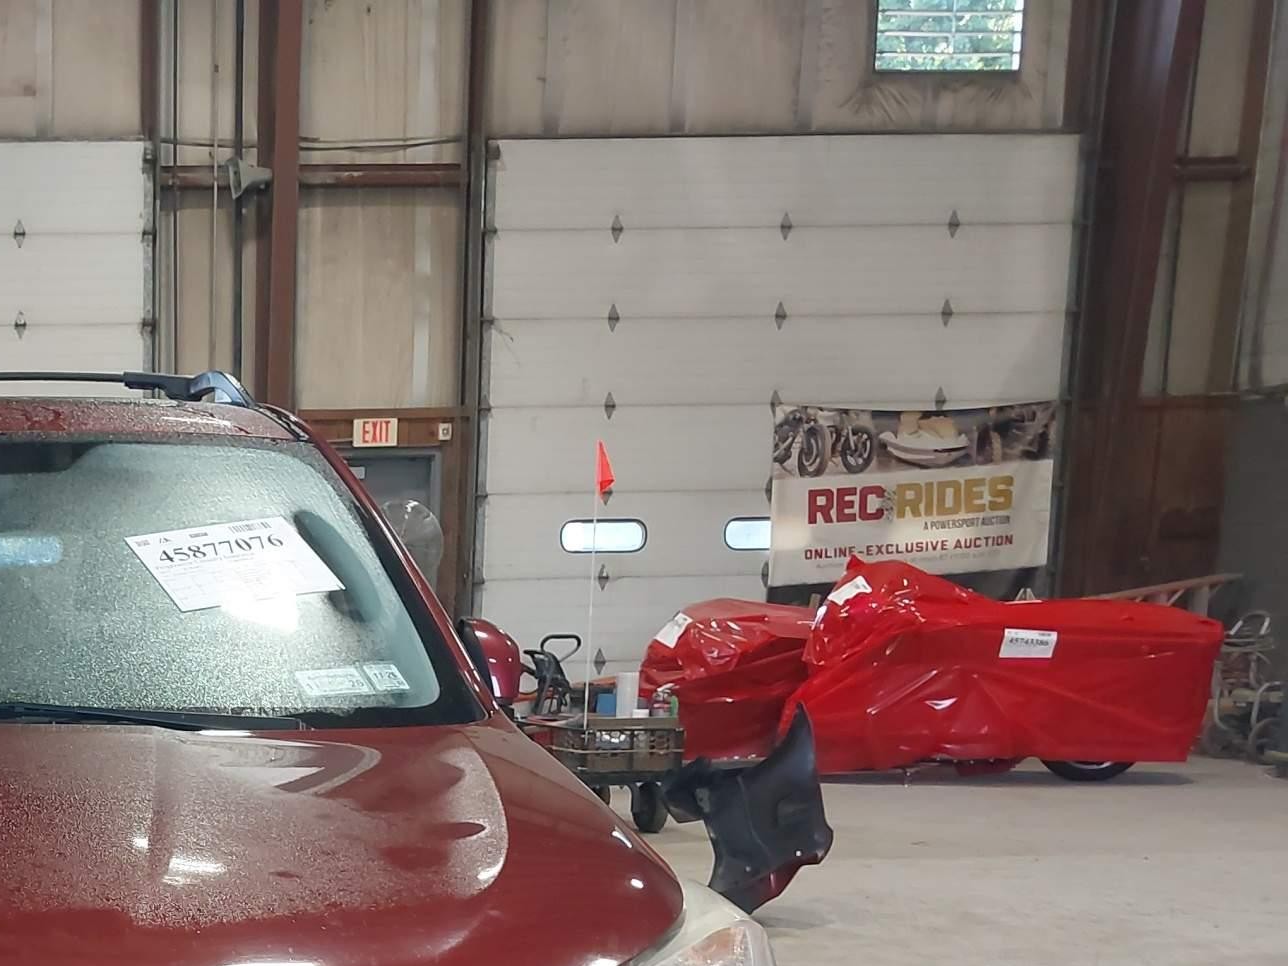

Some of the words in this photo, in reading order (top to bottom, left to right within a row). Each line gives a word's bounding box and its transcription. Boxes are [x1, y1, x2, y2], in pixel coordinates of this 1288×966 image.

[362, 420, 391, 443] EXIT
[808, 485, 885, 524] REC
[895, 475, 1014, 519] RIDES
[981, 515, 1011, 526] AUCTION
[159, 533, 284, 563] 45877076
[804, 539, 948, 560] ONLINE-EXCLUSIVE
[953, 534, 1014, 550] AUCTION
